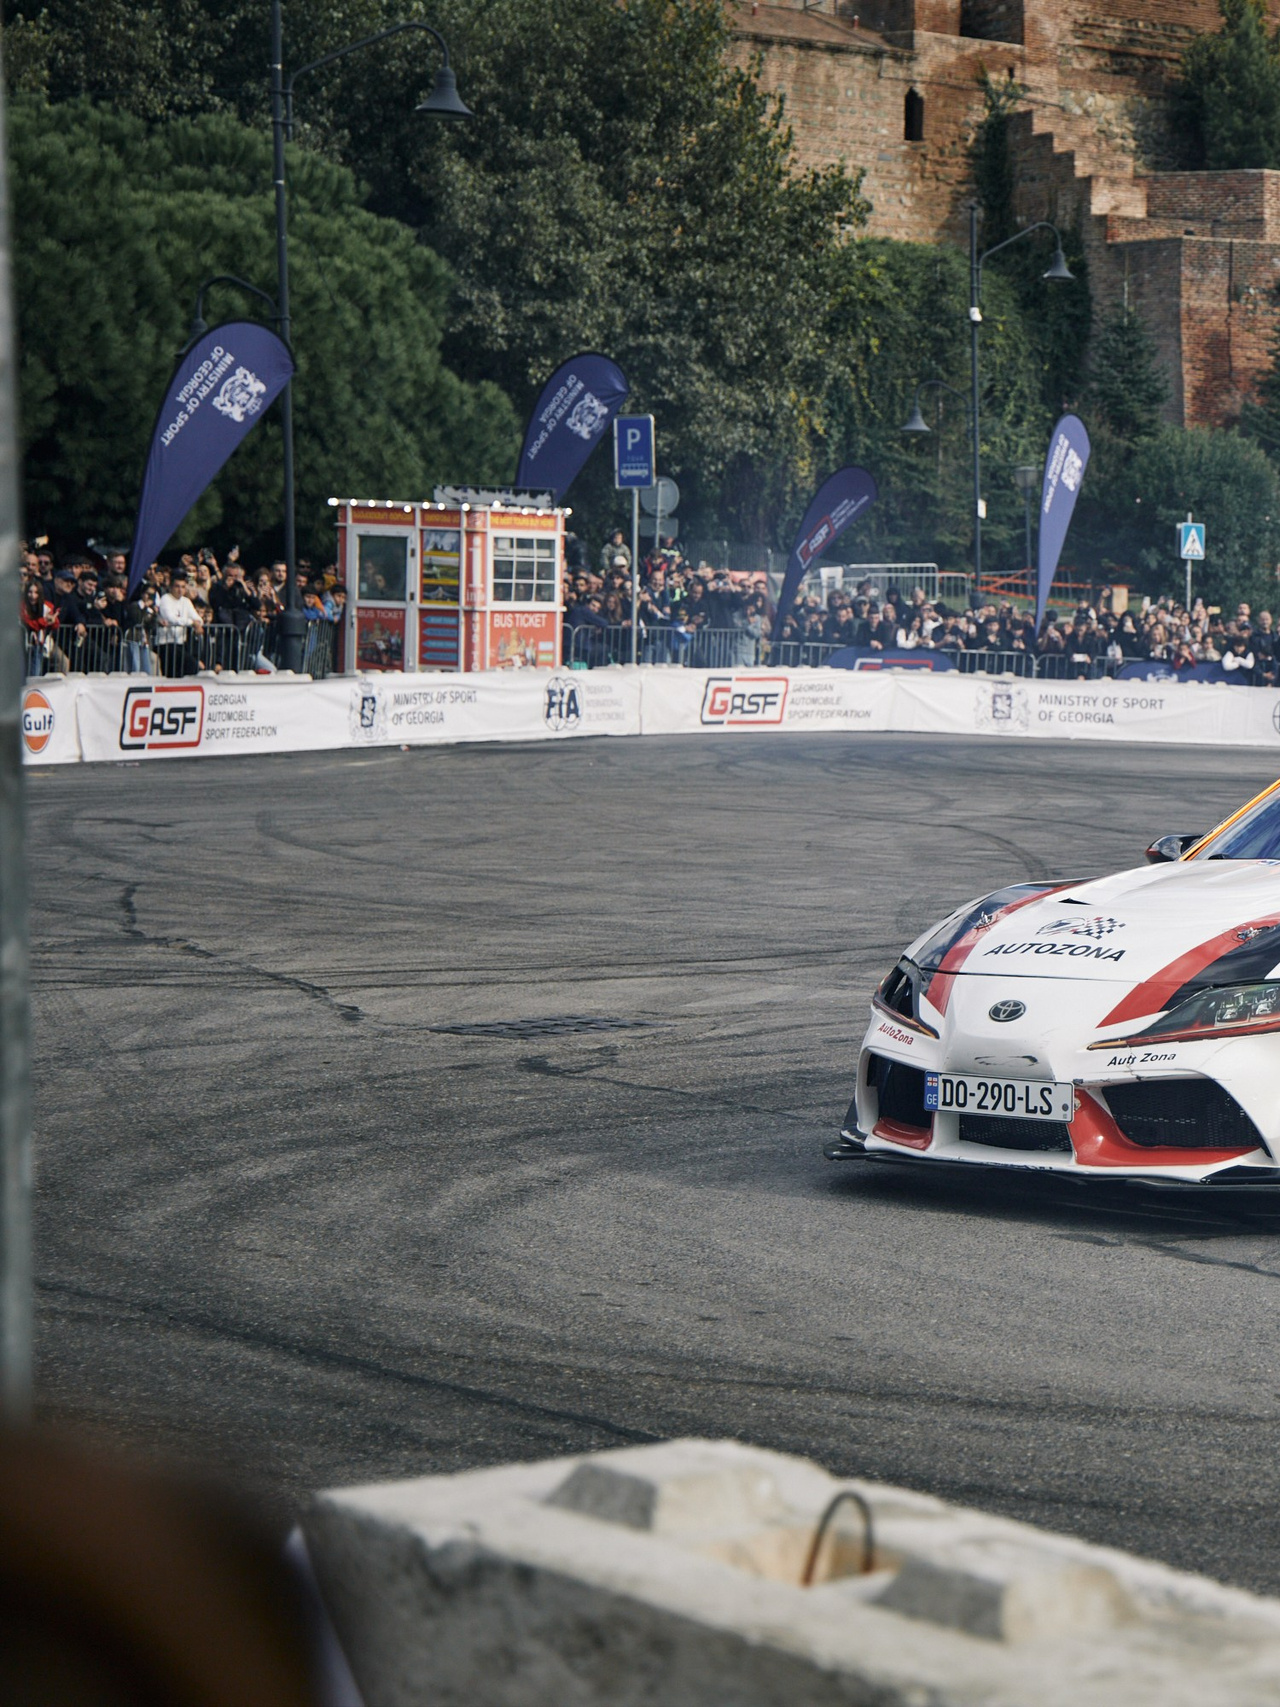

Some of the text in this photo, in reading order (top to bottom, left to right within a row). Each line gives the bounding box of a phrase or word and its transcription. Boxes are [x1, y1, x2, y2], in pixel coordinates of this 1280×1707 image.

[176, 346, 224, 404] OF GEORGIA
[160, 352, 235, 446] MINISTRY OF SPORT
[540, 374, 577, 423] OF GEORGIA
[527, 379, 585, 460] MINISTRY OF SPORT
[627, 428, 641, 450] P
[494, 613, 548, 628] BUS TICKET
[792, 684, 834, 692] GEORGIAN
[208, 694, 247, 706] GEORGIAN
[392, 690, 477, 706] MINISTRY OF SPORT
[708, 687, 779, 715] GASF
[789, 696, 842, 706] AUTOMOBILE
[1038, 694, 1164, 710] MINISTRY OF SPORT
[23, 713, 53, 731] Gulf
[129, 699, 197, 738] GASF
[206, 710, 255, 722] AUTOMOBILE
[391, 710, 444, 726] OF GEORGIA
[788, 709, 871, 720] SPORT FEDERATION
[1038, 710, 1114, 724] OF GEORGIA
[205, 726, 277, 740] SPORT FEDERATION
[982, 943, 1126, 962] AUTOZONA
[877, 1022, 914, 1045] AutoZona
[1140, 1052, 1177, 1063] Zona
[927, 1094, 938, 1105] GE
[941, 1078, 1053, 1115] DO-290-LS
